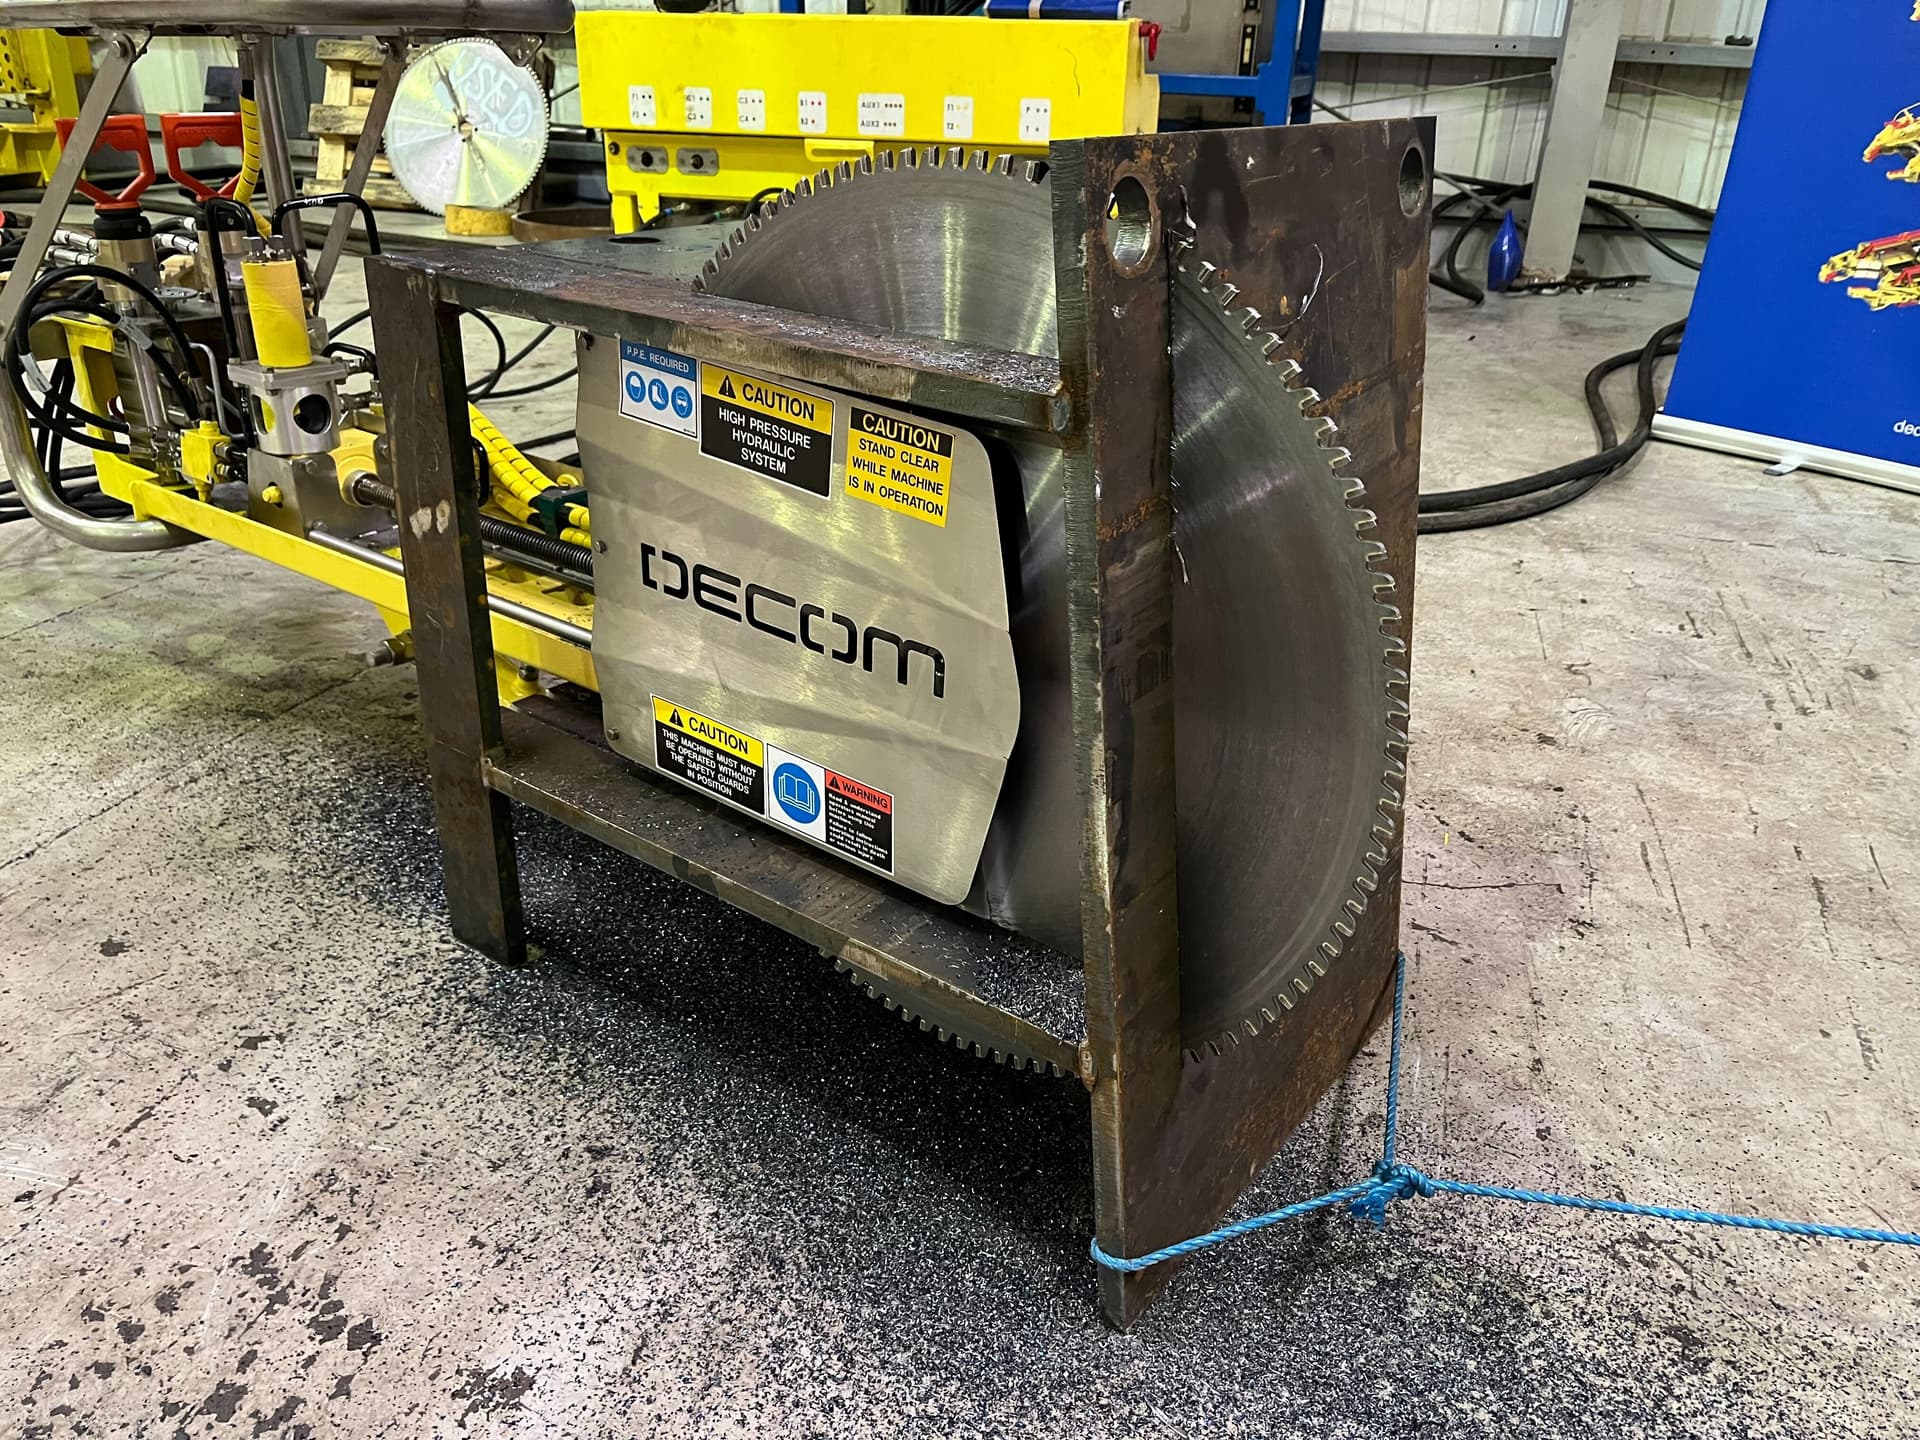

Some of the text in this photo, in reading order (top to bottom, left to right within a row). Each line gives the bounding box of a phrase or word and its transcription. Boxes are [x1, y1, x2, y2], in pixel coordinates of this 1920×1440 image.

[860, 101, 880, 110] AUX1
[860, 120, 880, 128] AUX2
[626, 346, 689, 372] P.P.E. REQUIRED
[742, 383, 815, 422] CAUTION
[718, 407, 812, 449] HIGH PRESSURE
[732, 428, 796, 460] HYDRAULIC
[862, 413, 940, 452] CAUTION
[740, 447, 786, 474] SYSTEM
[858, 438, 940, 474] STAND CLEAR
[848, 474, 944, 517] IS IN OPERATION
[852, 456, 944, 496] WHILE MACHINE
[640, 542, 946, 699] DECOM
[662, 728, 758, 778] THIS MACHINE MUST NOT
[688, 716, 748, 755] CAUTION
[665, 740, 754, 786] BE OPERATED WITHOUT
[670, 751, 750, 796] THE SAFETY GUARDS
[686, 768, 732, 796] IN POSITION
[842, 781, 888, 809] WARNING
